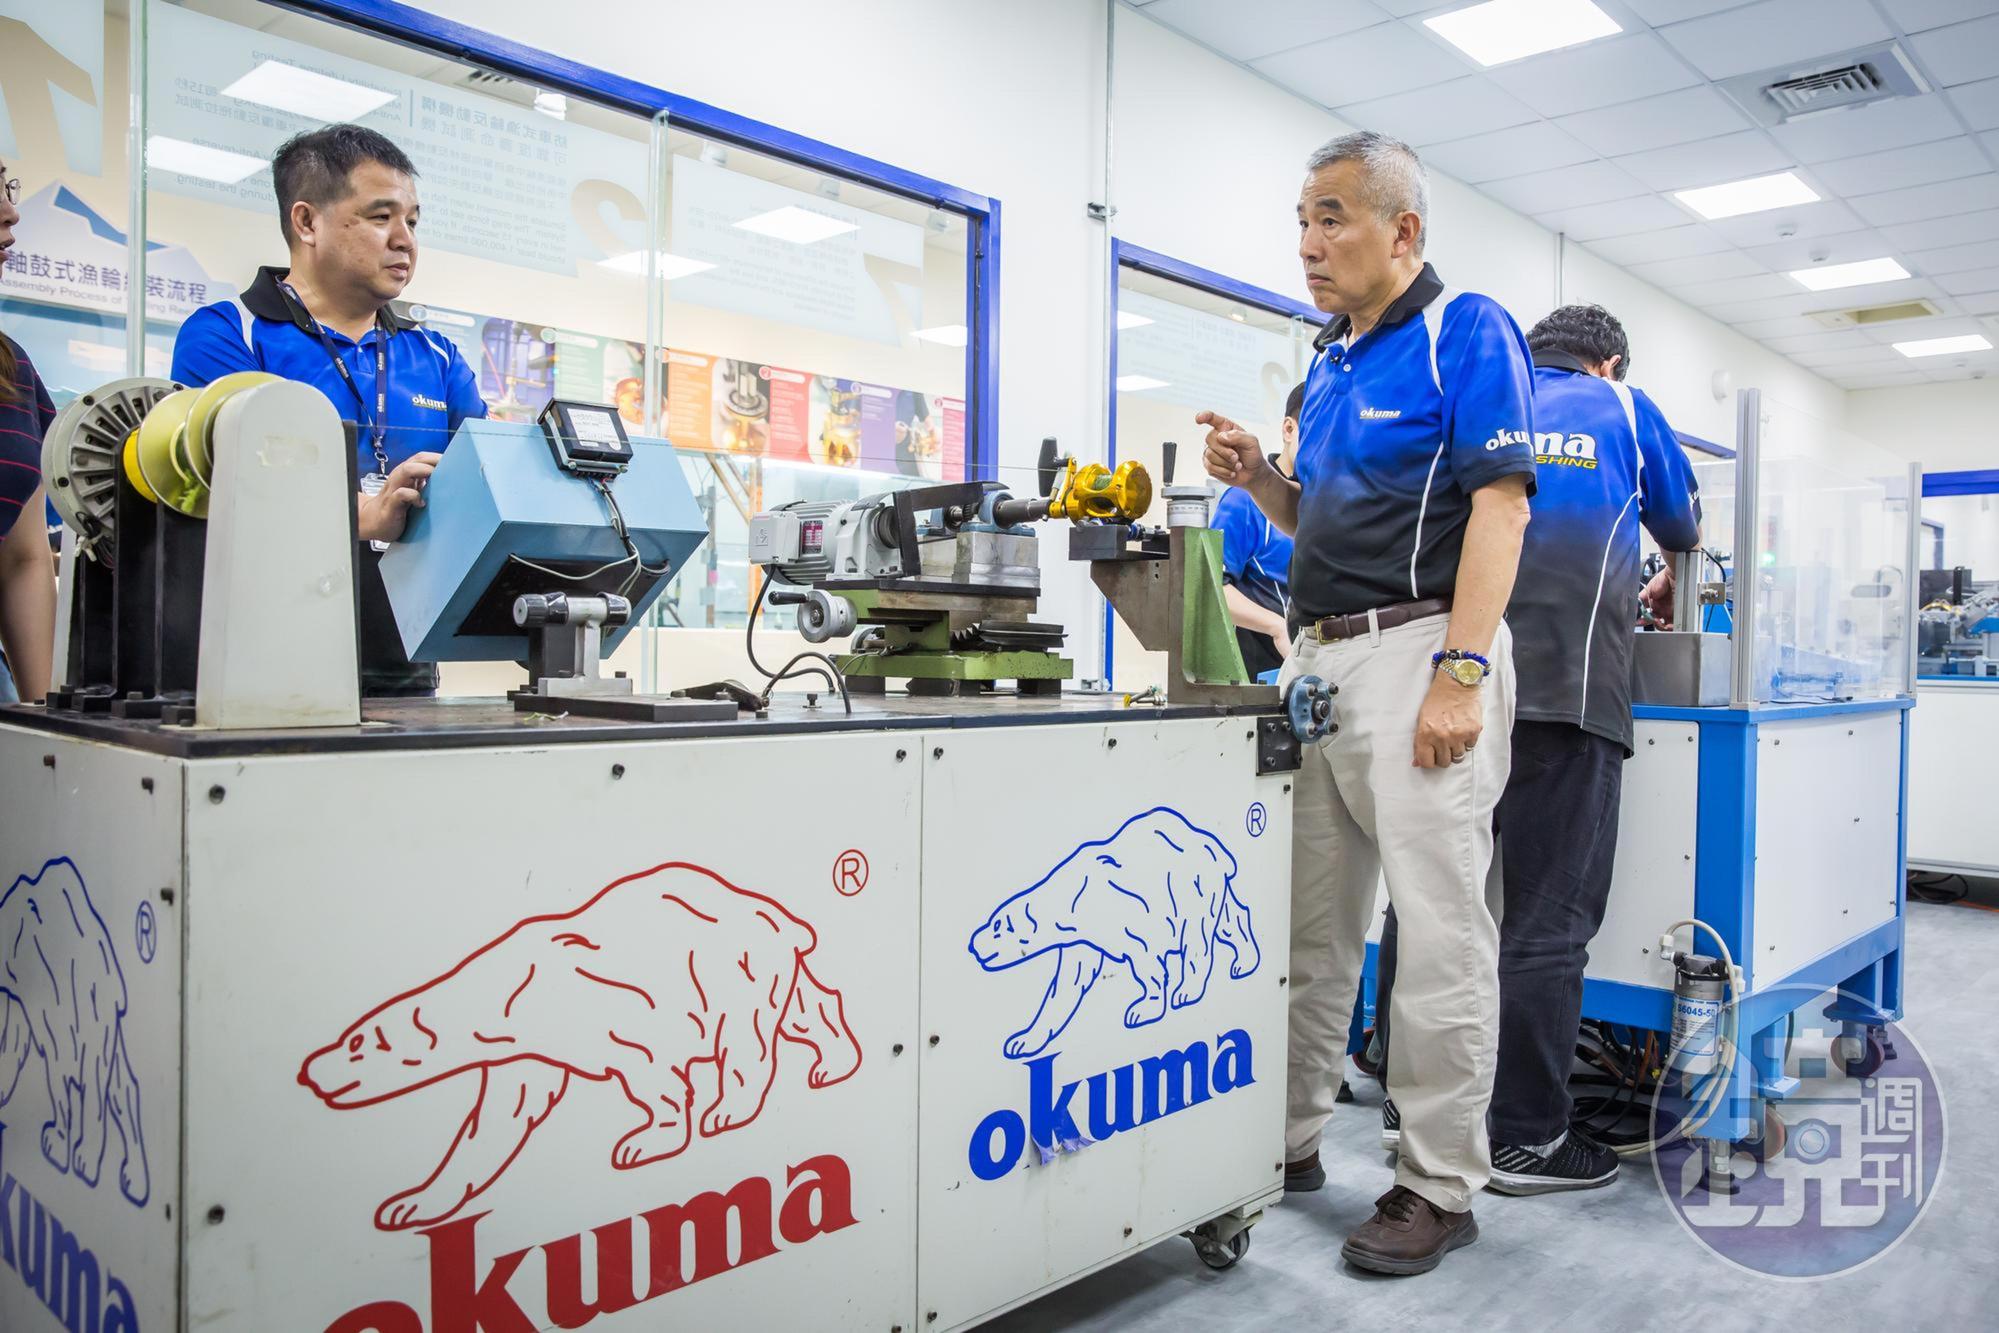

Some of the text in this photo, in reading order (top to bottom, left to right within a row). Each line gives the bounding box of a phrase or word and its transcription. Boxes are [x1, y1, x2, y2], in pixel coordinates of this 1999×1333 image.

[5, 250, 208, 305] 軸鼓式漁輪裝流程
[59, 286, 108, 304] Process
[1360, 406, 1402, 418] okuma
[1485, 428, 1533, 452] oku
[1536, 455, 1598, 470] SHING
[968, 1028, 1256, 1181] okuma
[322, 1154, 861, 1333] kuma
